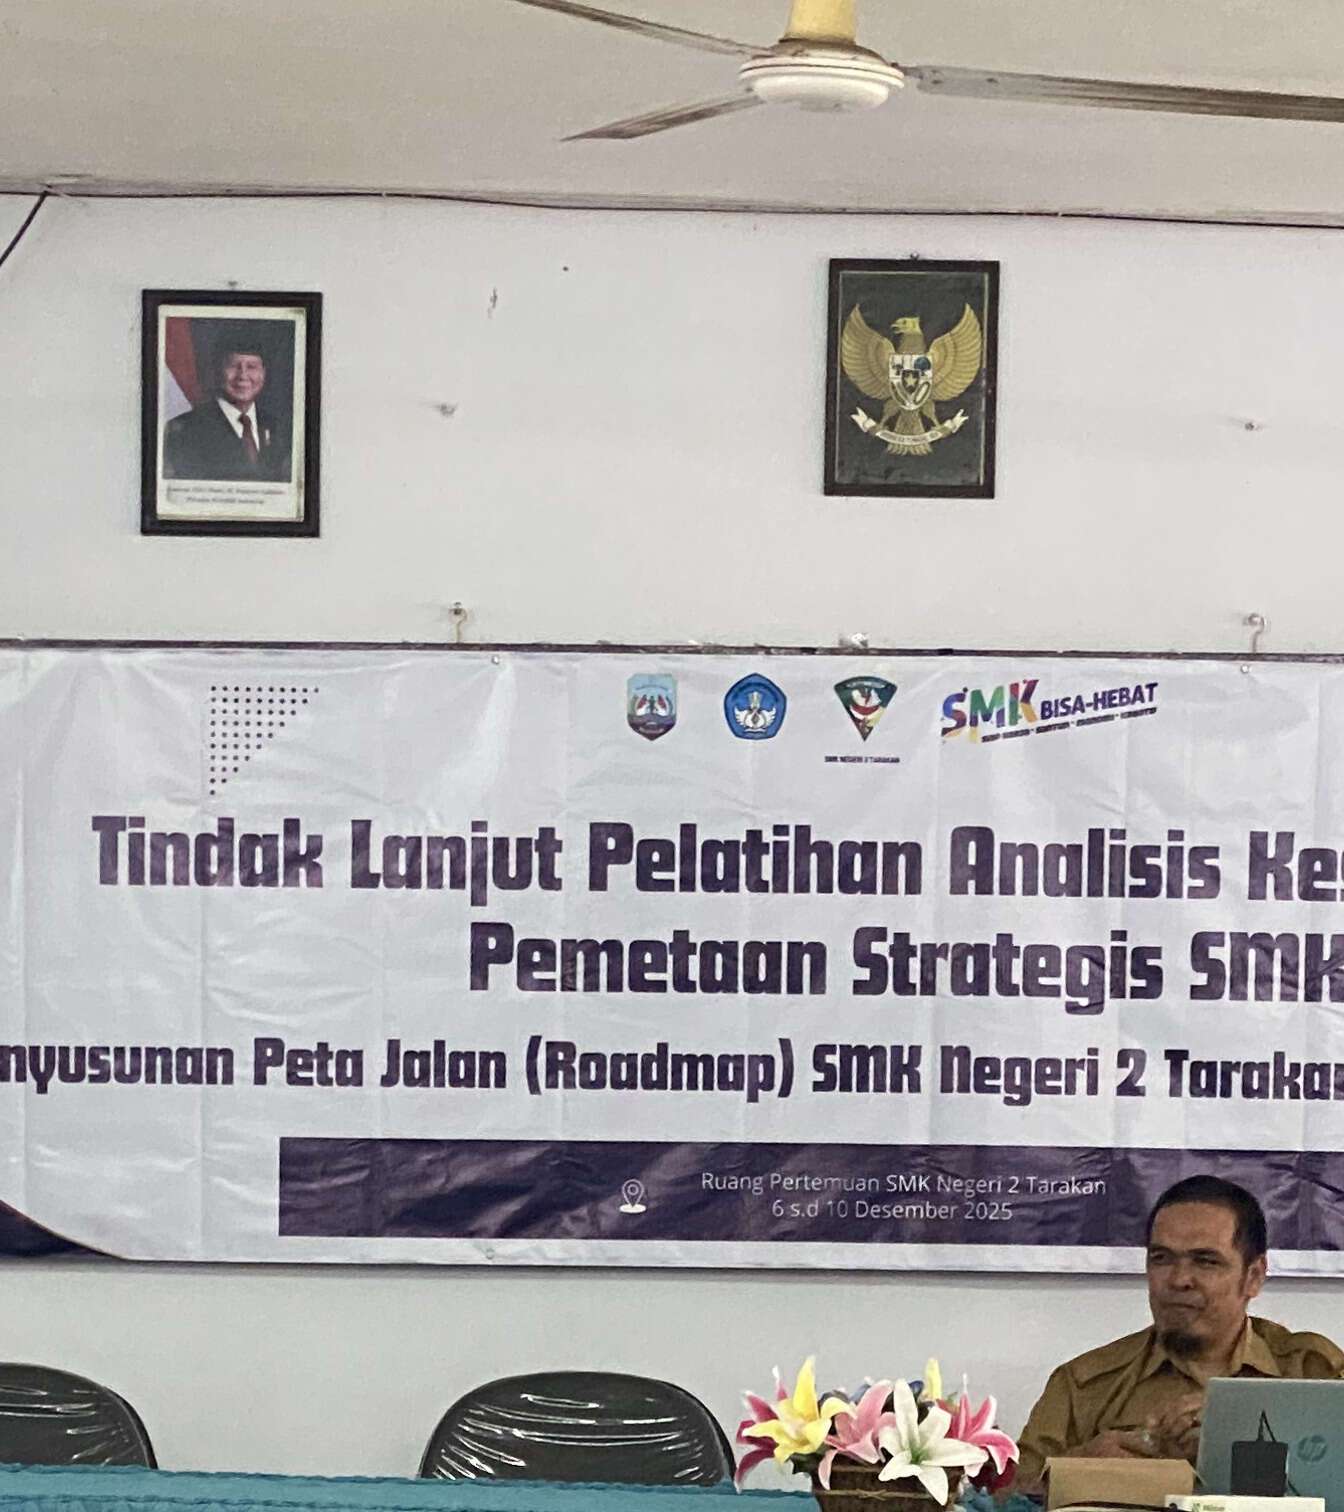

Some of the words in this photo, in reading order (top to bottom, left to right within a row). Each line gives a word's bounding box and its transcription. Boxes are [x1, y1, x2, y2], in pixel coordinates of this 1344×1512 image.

[941, 679, 1040, 742] SMK
[1039, 682, 1159, 721] BISA-HEBAT
[91, 815, 324, 889] Tindak
[350, 819, 563, 906] Lanjut
[588, 821, 923, 896] Pelatihan
[949, 825, 1221, 900] Analisis
[469, 921, 827, 996] Pemetaan
[852, 926, 1164, 1016] Strategis
[253, 1037, 364, 1089] Peta
[379, 1038, 507, 1090] Jalan
[525, 1034, 795, 1104] (Roadmap)
[812, 1043, 923, 1094] SMK
[939, 1044, 1099, 1107] Negeri
[1116, 1048, 1147, 1097] 2
[701, 1172, 764, 1196] Ruang
[769, 1173, 880, 1192] Pertemuan
[885, 1174, 930, 1193] SMK
[936, 1175, 1002, 1198] Negeri
[1007, 1176, 1020, 1194] 2
[1025, 1175, 1106, 1195] Tarakan
[771, 1199, 785, 1218] 6
[789, 1199, 819, 1218] s.d
[826, 1200, 849, 1218] 10
[855, 1200, 958, 1220] Desember
[963, 1201, 1014, 1221] 2025
